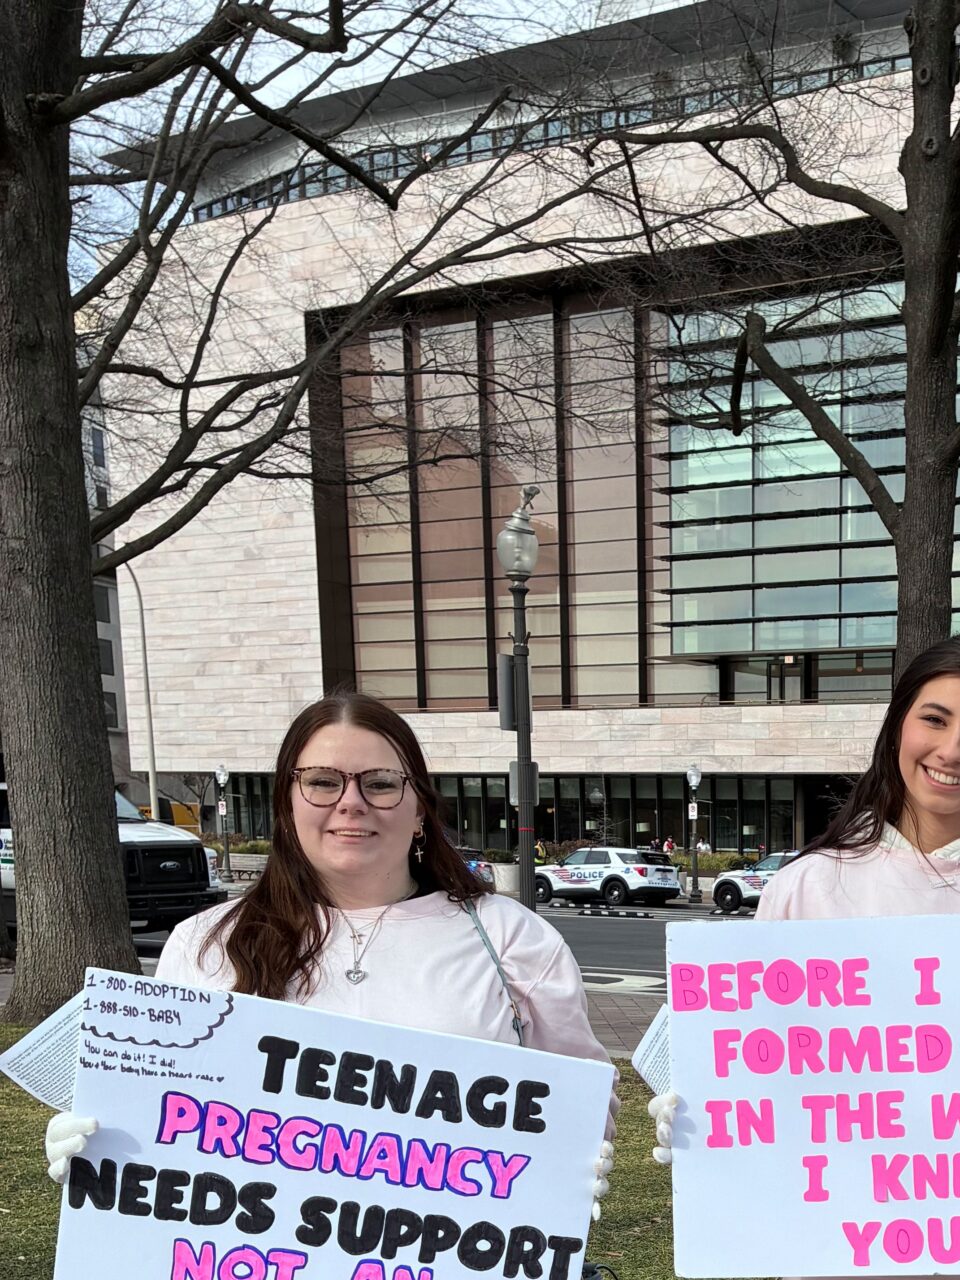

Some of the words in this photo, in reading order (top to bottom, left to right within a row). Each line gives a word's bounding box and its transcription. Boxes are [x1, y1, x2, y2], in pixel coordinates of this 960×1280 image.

[570, 871, 604, 879] POLICE
[671, 957, 872, 1013] BEFORE
[914, 957, 941, 1006] I
[84, 1039, 100, 1055] You
[103, 1048, 118, 1058] can
[121, 1050, 132, 1061] do
[133, 1052, 146, 1062] it!
[148, 1054, 157, 1065] I
[160, 1057, 176, 1069] did!
[121, 1063, 140, 1077] baby
[168, 1069, 193, 1079] heart
[195, 1073, 214, 1082] rate
[713, 1024, 953, 1078] FORMED
[257, 1035, 551, 1134] TEENAGE
[156, 1091, 531, 1199] PREGNANCY
[705, 1098, 775, 1149] IN
[802, 1090, 906, 1143] THE
[67, 1156, 277, 1235] NEEDS
[802, 1154, 829, 1203] I
